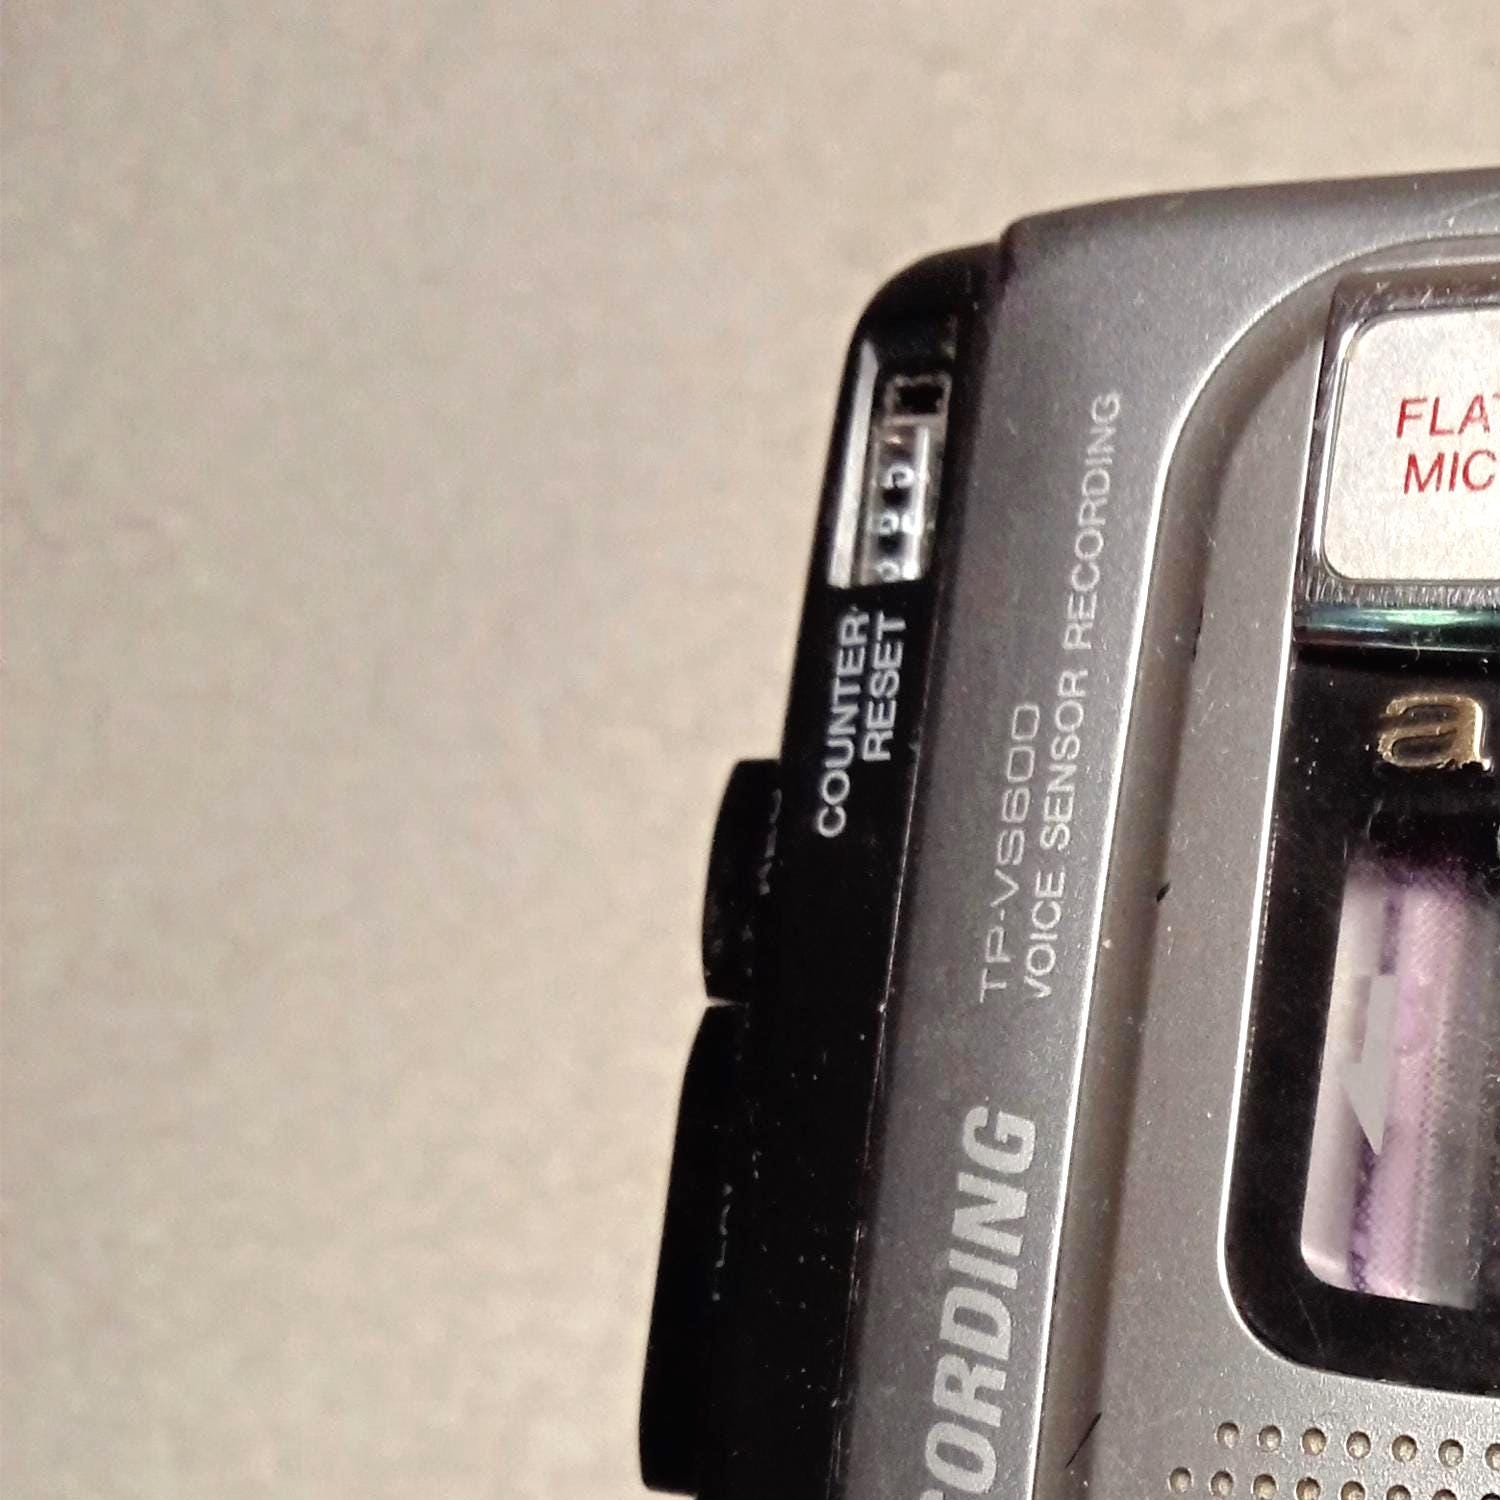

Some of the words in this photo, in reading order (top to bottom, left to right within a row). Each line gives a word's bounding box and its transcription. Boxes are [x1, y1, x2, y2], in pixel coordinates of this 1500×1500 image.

[1063, 391, 1121, 651] RECORDING
[1402, 448, 1497, 495] MIC
[816, 606, 870, 838] COUNTER
[862, 610, 906, 762] RESET
[1040, 667, 1088, 852] SENSOR
[980, 702, 1041, 1003] TP-VS600
[1021, 866, 1066, 999] VOICE
